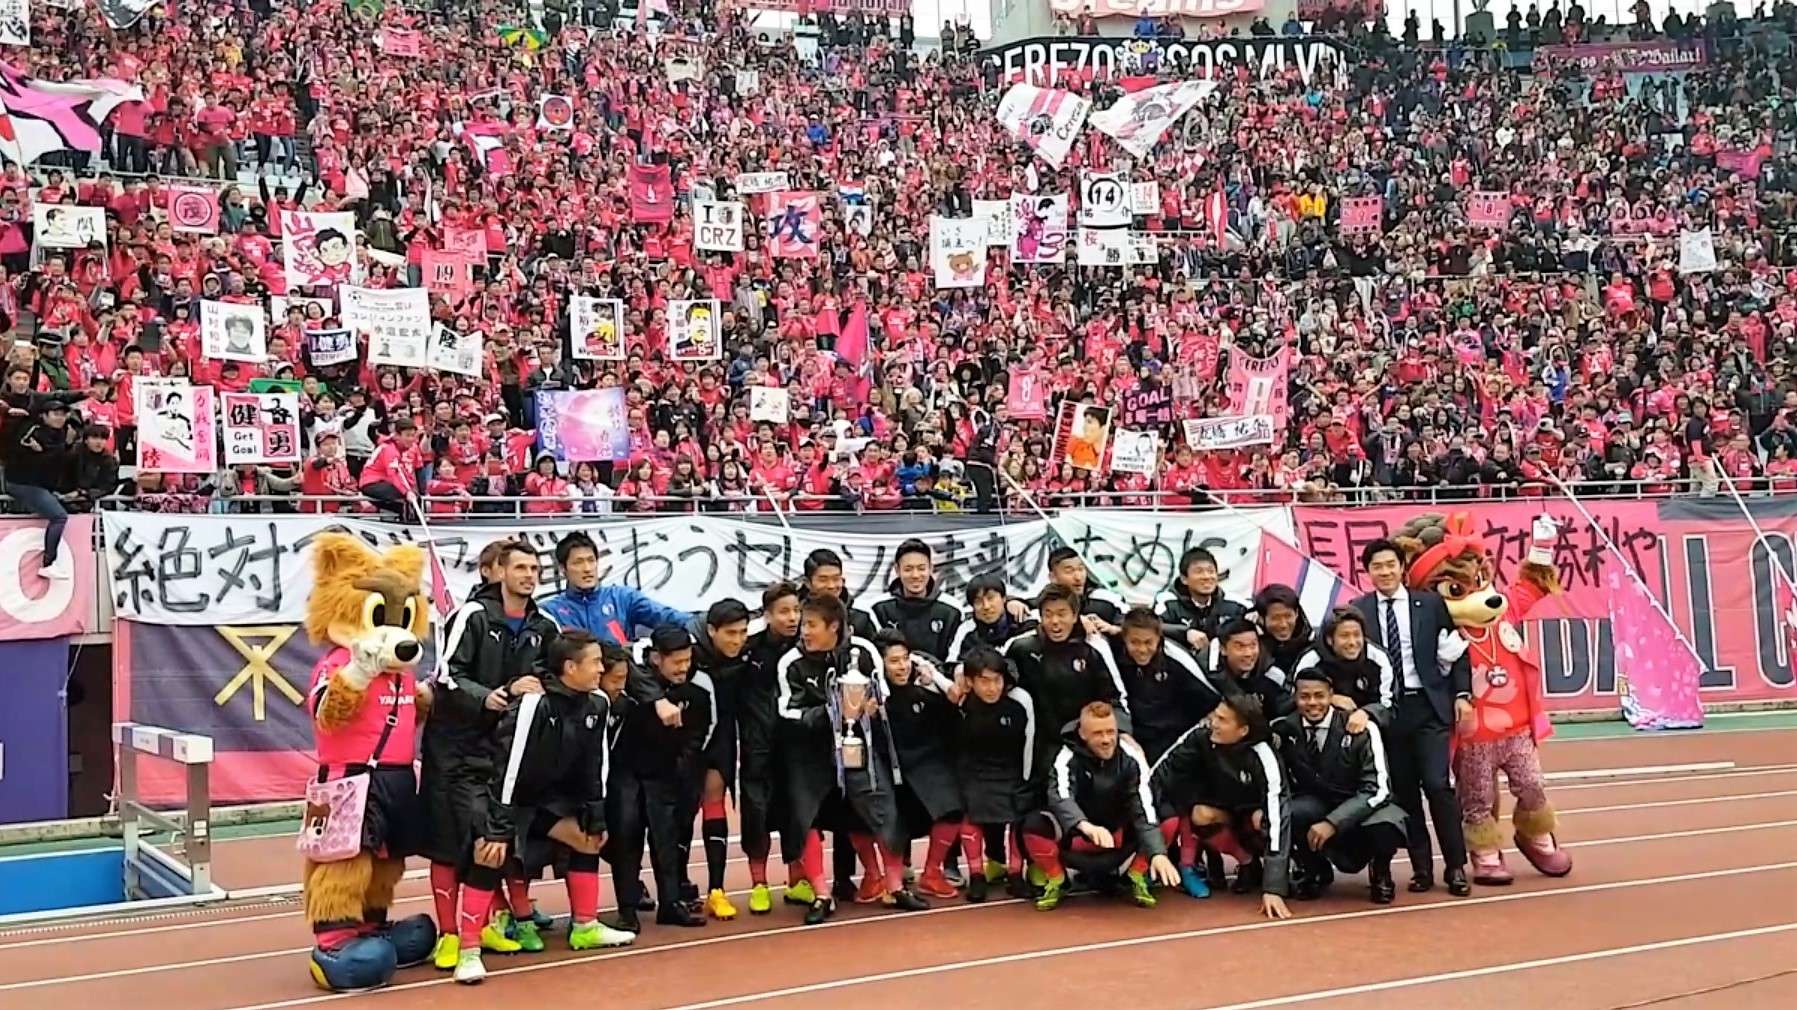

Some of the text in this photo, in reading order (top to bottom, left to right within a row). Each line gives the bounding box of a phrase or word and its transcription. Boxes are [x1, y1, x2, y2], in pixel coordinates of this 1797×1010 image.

[1095, 186, 1115, 205] 14
[702, 205, 714, 224] I
[700, 226, 736, 246] CRZ
[1127, 388, 1170, 411] GOAL
[231, 404, 258, 425] 健
[234, 431, 254, 441] Get
[269, 430, 291, 455] 勇
[233, 445, 257, 455] Goal
